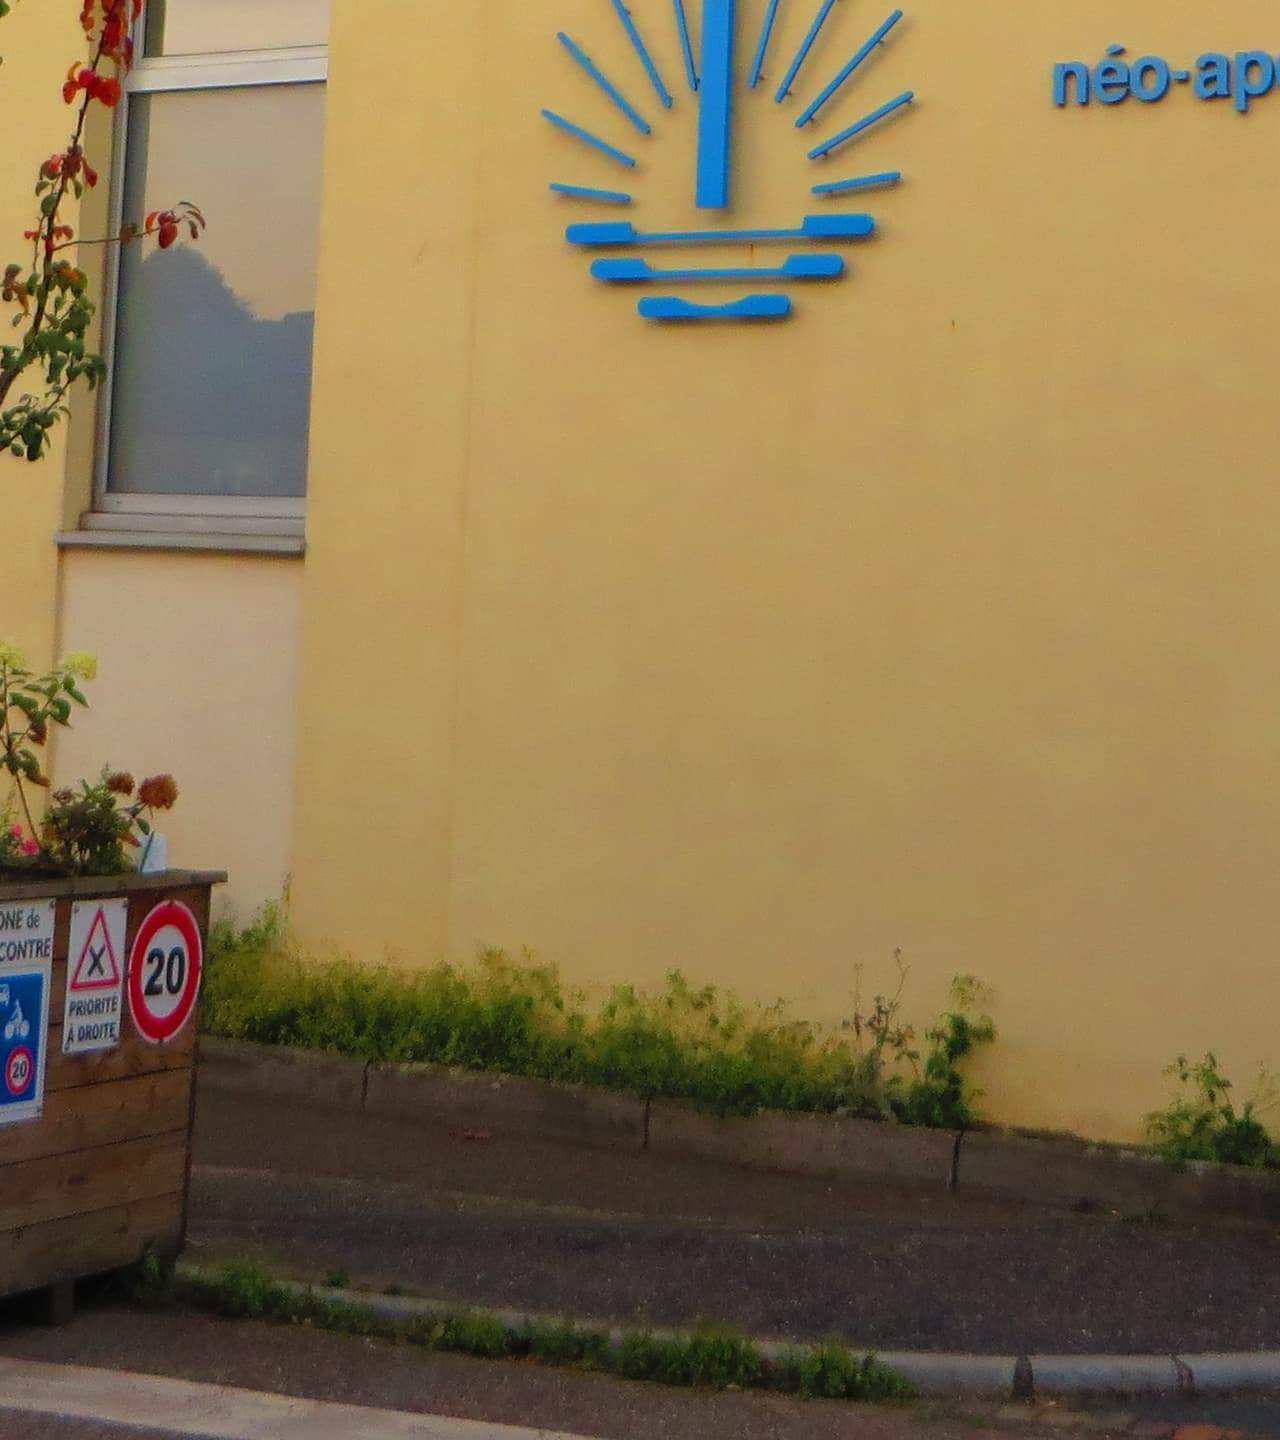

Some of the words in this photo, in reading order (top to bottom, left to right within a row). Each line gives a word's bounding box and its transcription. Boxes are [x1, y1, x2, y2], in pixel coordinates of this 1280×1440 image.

[26, 910, 40, 928] de
[144, 946, 186, 996] 20
[69, 992, 118, 1016] PRIORITÉ
[78, 1022, 116, 1042] DROITE
[12, 1061, 28, 1079] 20
